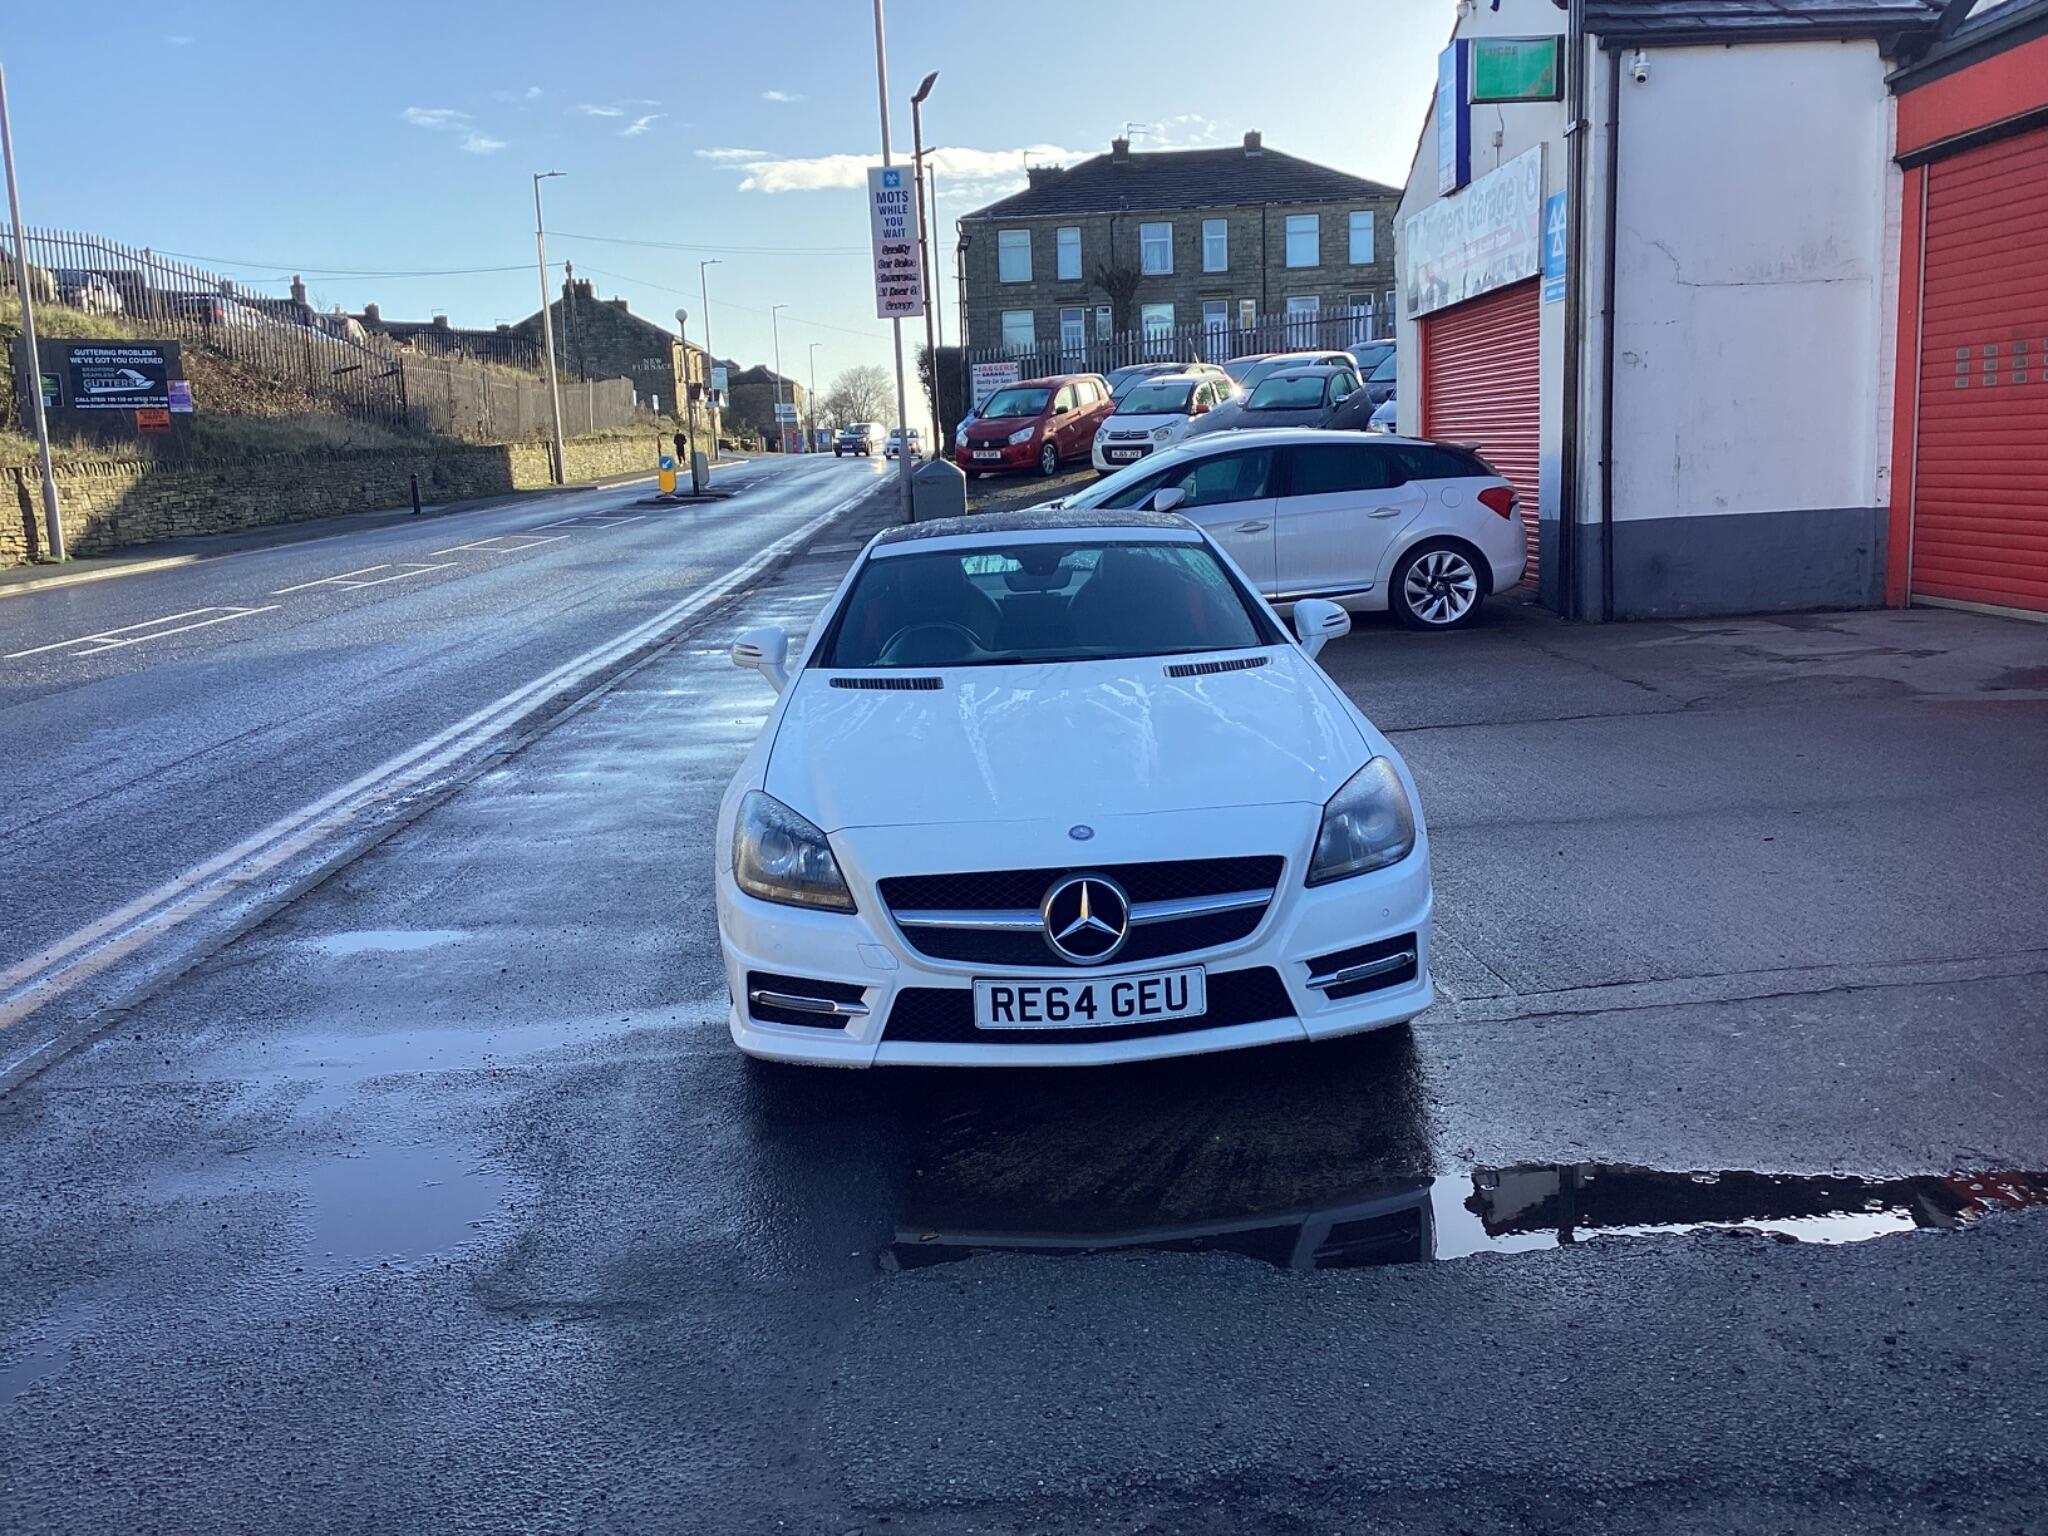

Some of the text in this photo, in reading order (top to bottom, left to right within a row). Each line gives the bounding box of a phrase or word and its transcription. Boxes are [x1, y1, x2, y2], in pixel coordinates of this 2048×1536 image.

[876, 190, 909, 204] MOTS
[878, 203, 908, 216] WHILE
[1467, 176, 1513, 232] Garage
[884, 216, 903, 227] YOU
[883, 227, 906, 239] WAIT
[117, 348, 157, 356] PROBLEM?
[642, 357, 662, 365] NEW
[978, 364, 1015, 372] JAGGERS
[82, 378, 136, 388] GUTTERS
[990, 974, 1189, 1023] RE64 GEU
